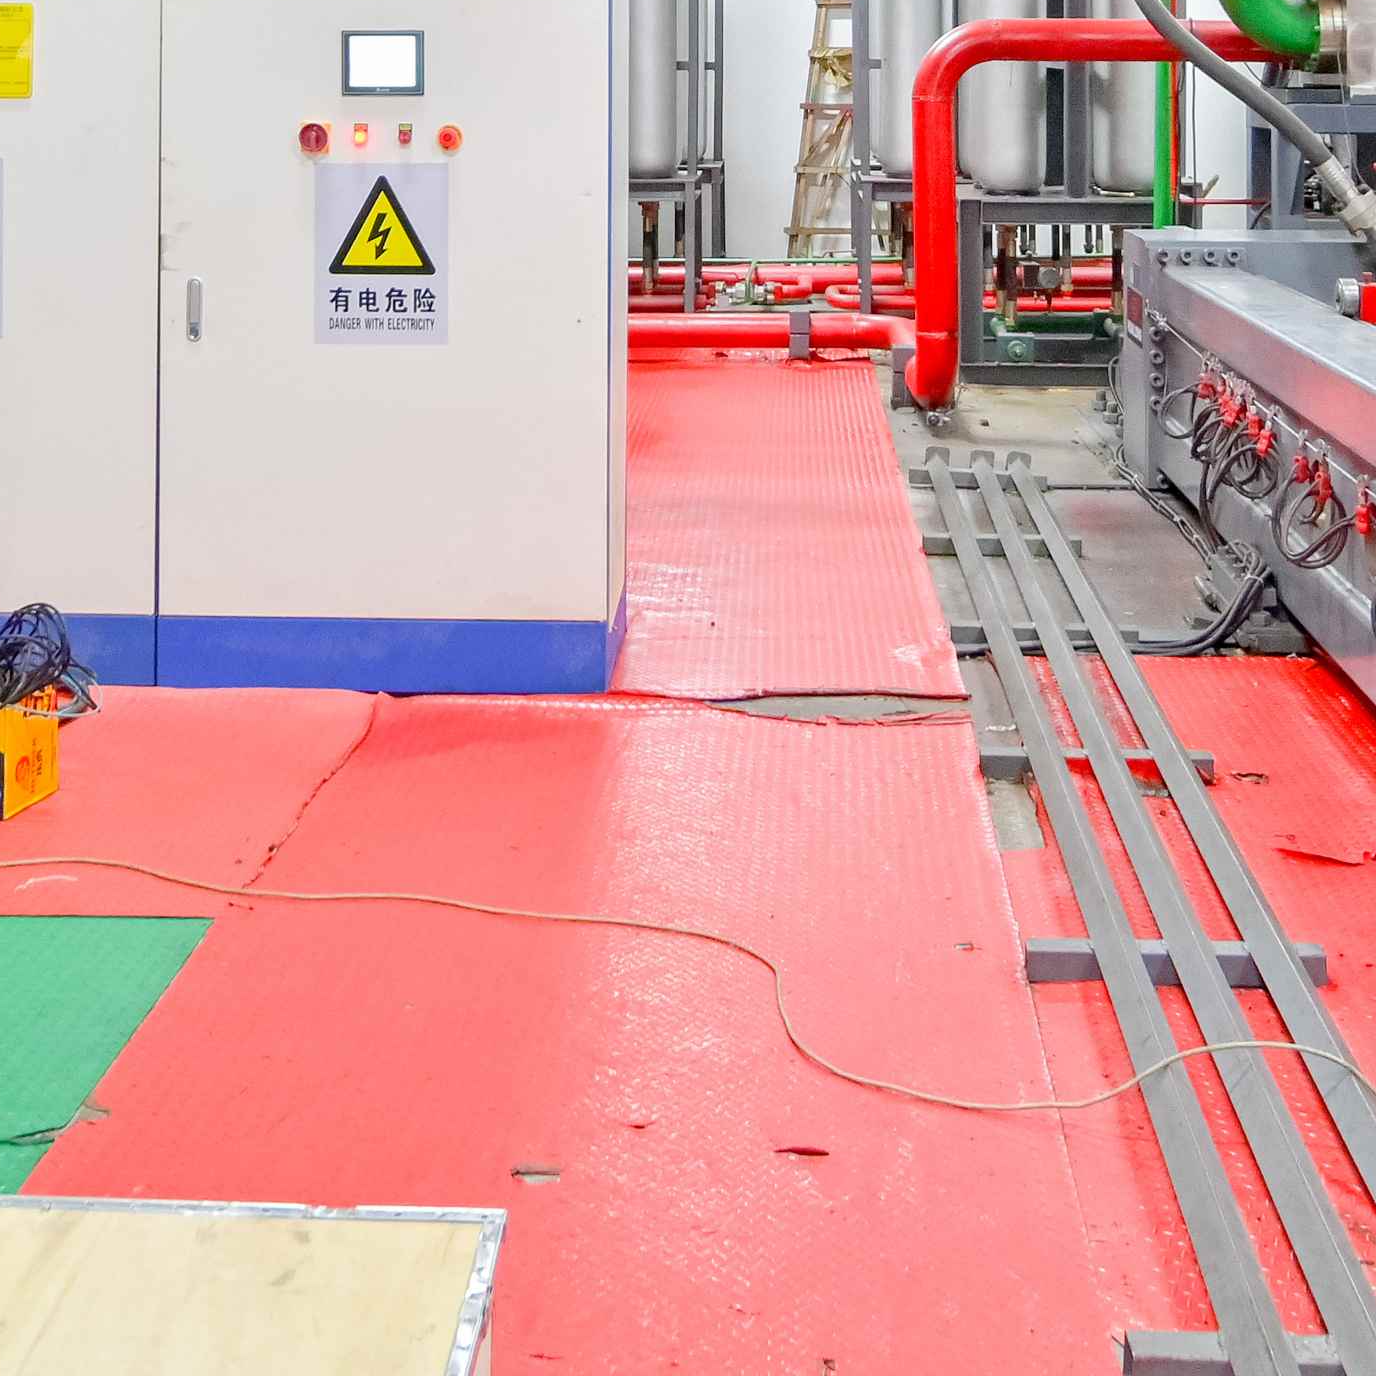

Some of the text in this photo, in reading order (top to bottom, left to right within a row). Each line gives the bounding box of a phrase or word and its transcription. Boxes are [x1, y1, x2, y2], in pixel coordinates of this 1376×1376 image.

[329, 287, 436, 313] 有电危险
[329, 317, 436, 331] DANGER WITH ELECTRICITY
